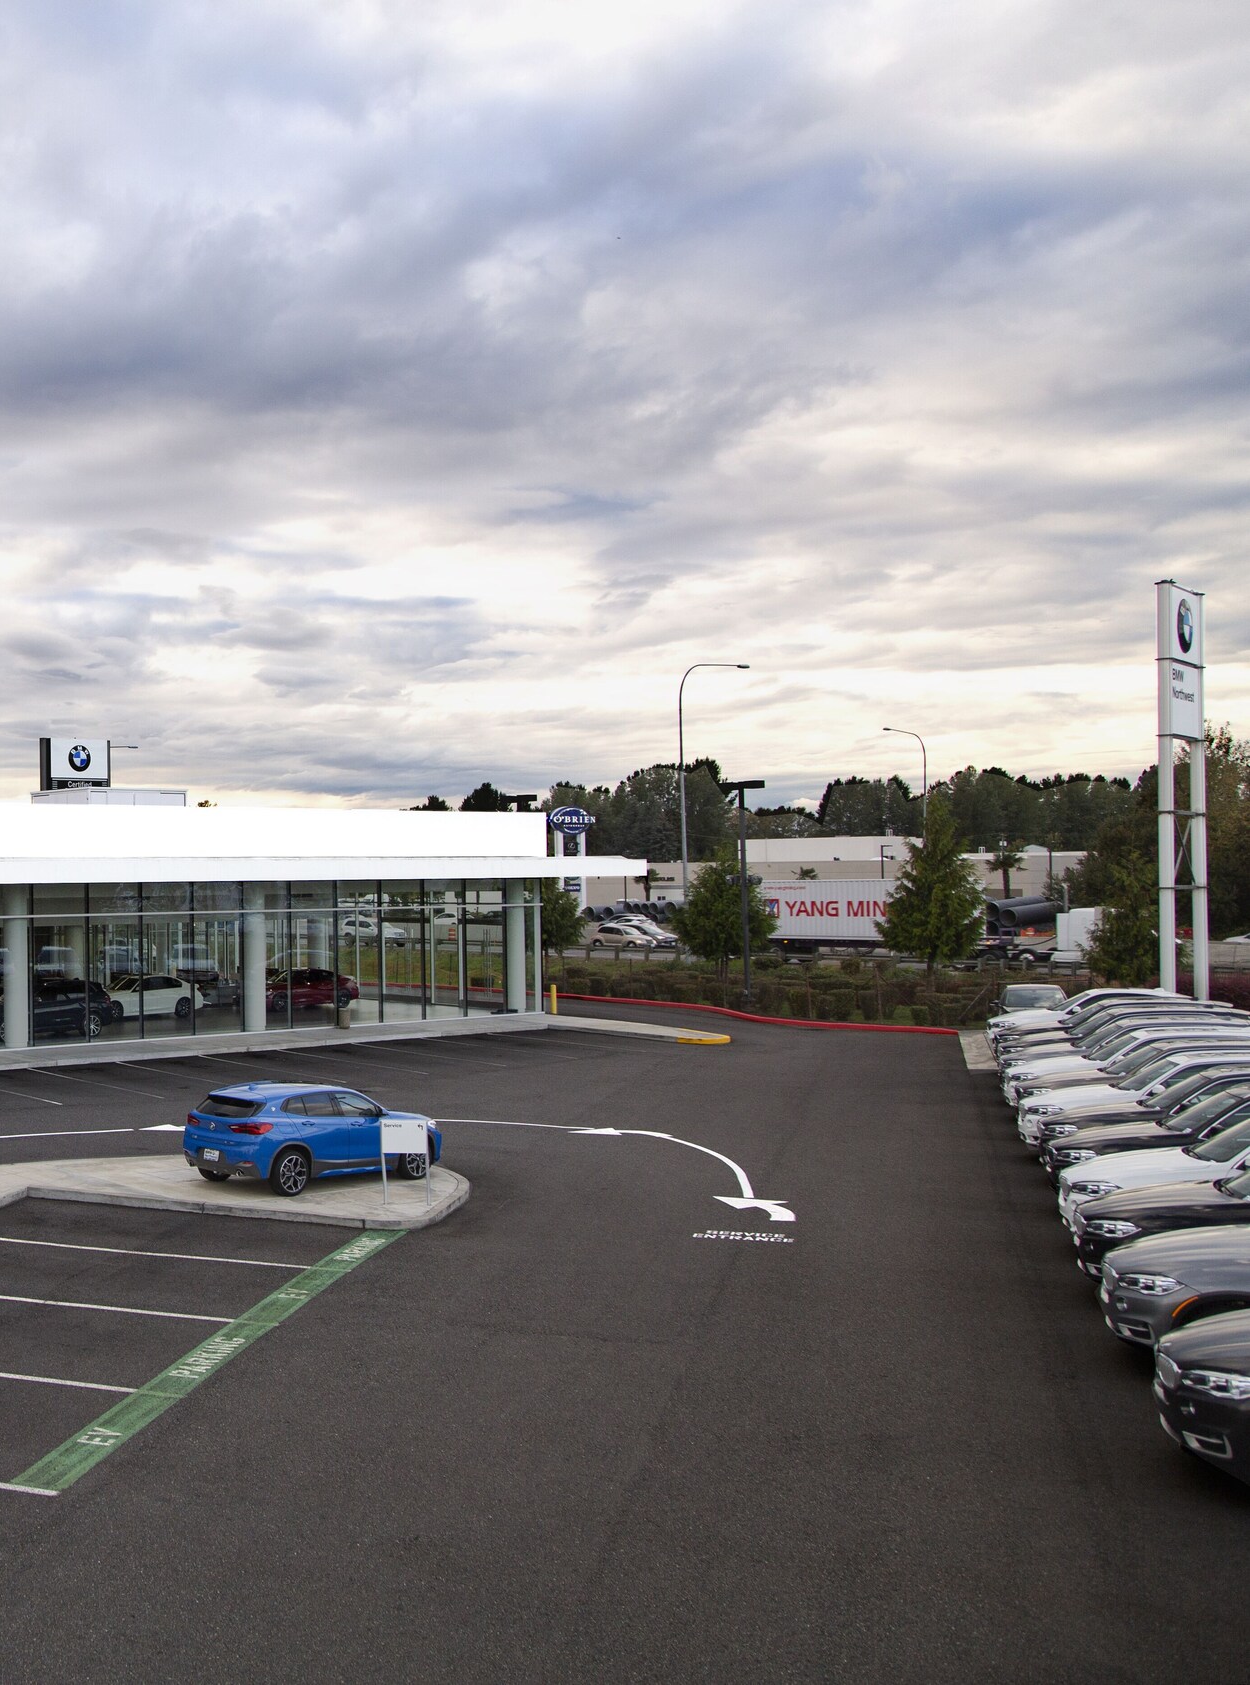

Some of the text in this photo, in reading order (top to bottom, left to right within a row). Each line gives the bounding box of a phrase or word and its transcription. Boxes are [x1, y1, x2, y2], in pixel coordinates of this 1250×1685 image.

[1172, 668, 1184, 683] BMW
[1172, 686, 1195, 703] Northwest
[553, 815, 596, 823] O'BRIEN
[785, 900, 888, 918] YANG MIN
[692, 1233, 795, 1243] ENTRANCE
[705, 1230, 786, 1238] SERVICE
[277, 1237, 386, 1299] EV PARKING
[77, 1336, 246, 1446] EV PARKING
